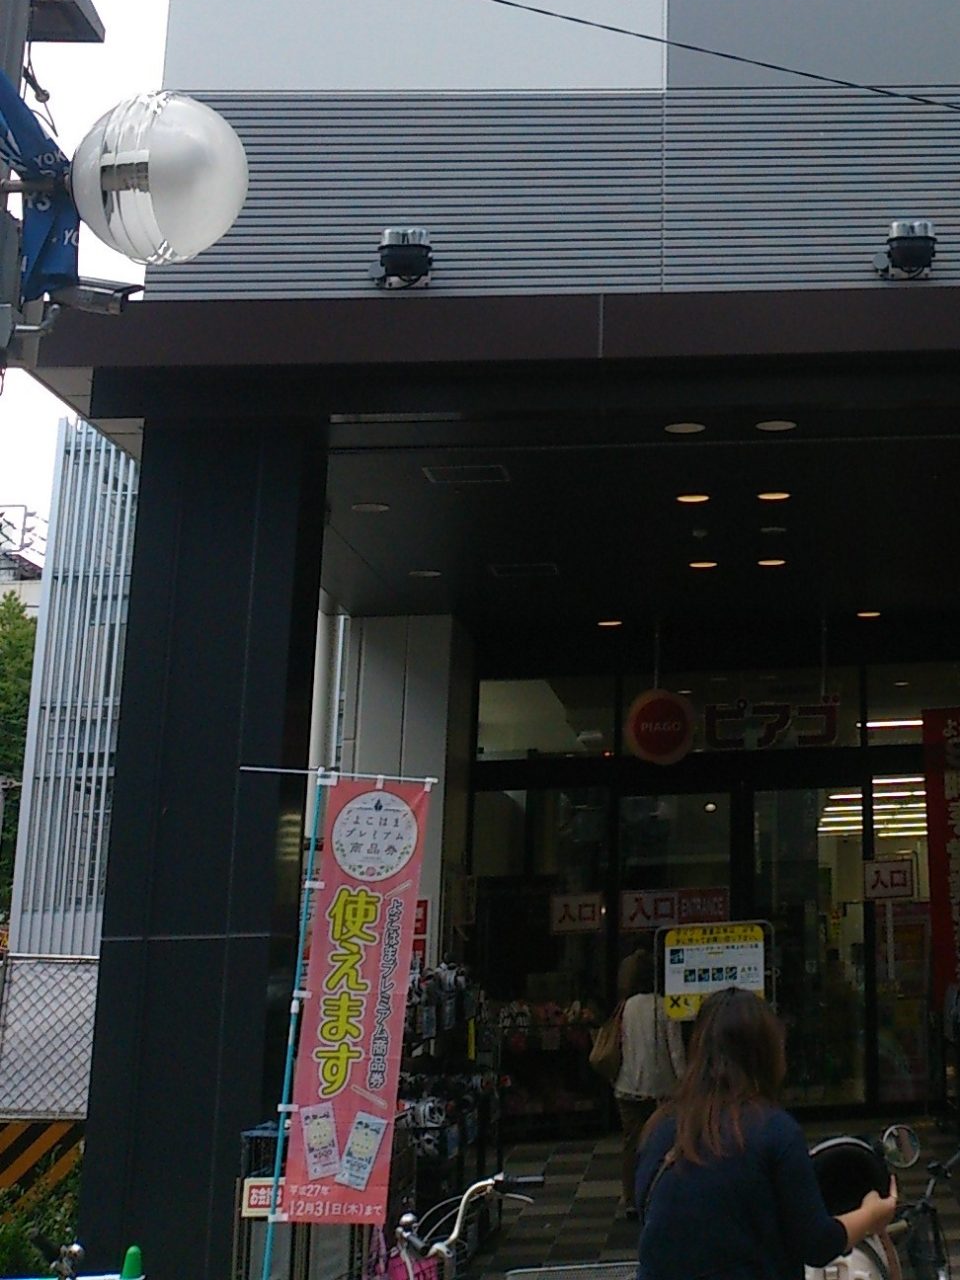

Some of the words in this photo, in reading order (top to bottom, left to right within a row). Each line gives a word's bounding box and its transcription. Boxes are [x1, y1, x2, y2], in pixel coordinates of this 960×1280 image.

[640, 722, 681, 732] PIAGO
[704, 694, 840, 751] ピアゴ
[871, 870, 907, 889] 入口
[559, 904, 595, 923] 入口
[630, 897, 675, 921] 入口
[314, 886, 381, 1097] 使えます
[369, 899, 402, 1089] よこはまプレミアム商品券
[289, 1200, 383, 1217] 12月31日(木)まで
